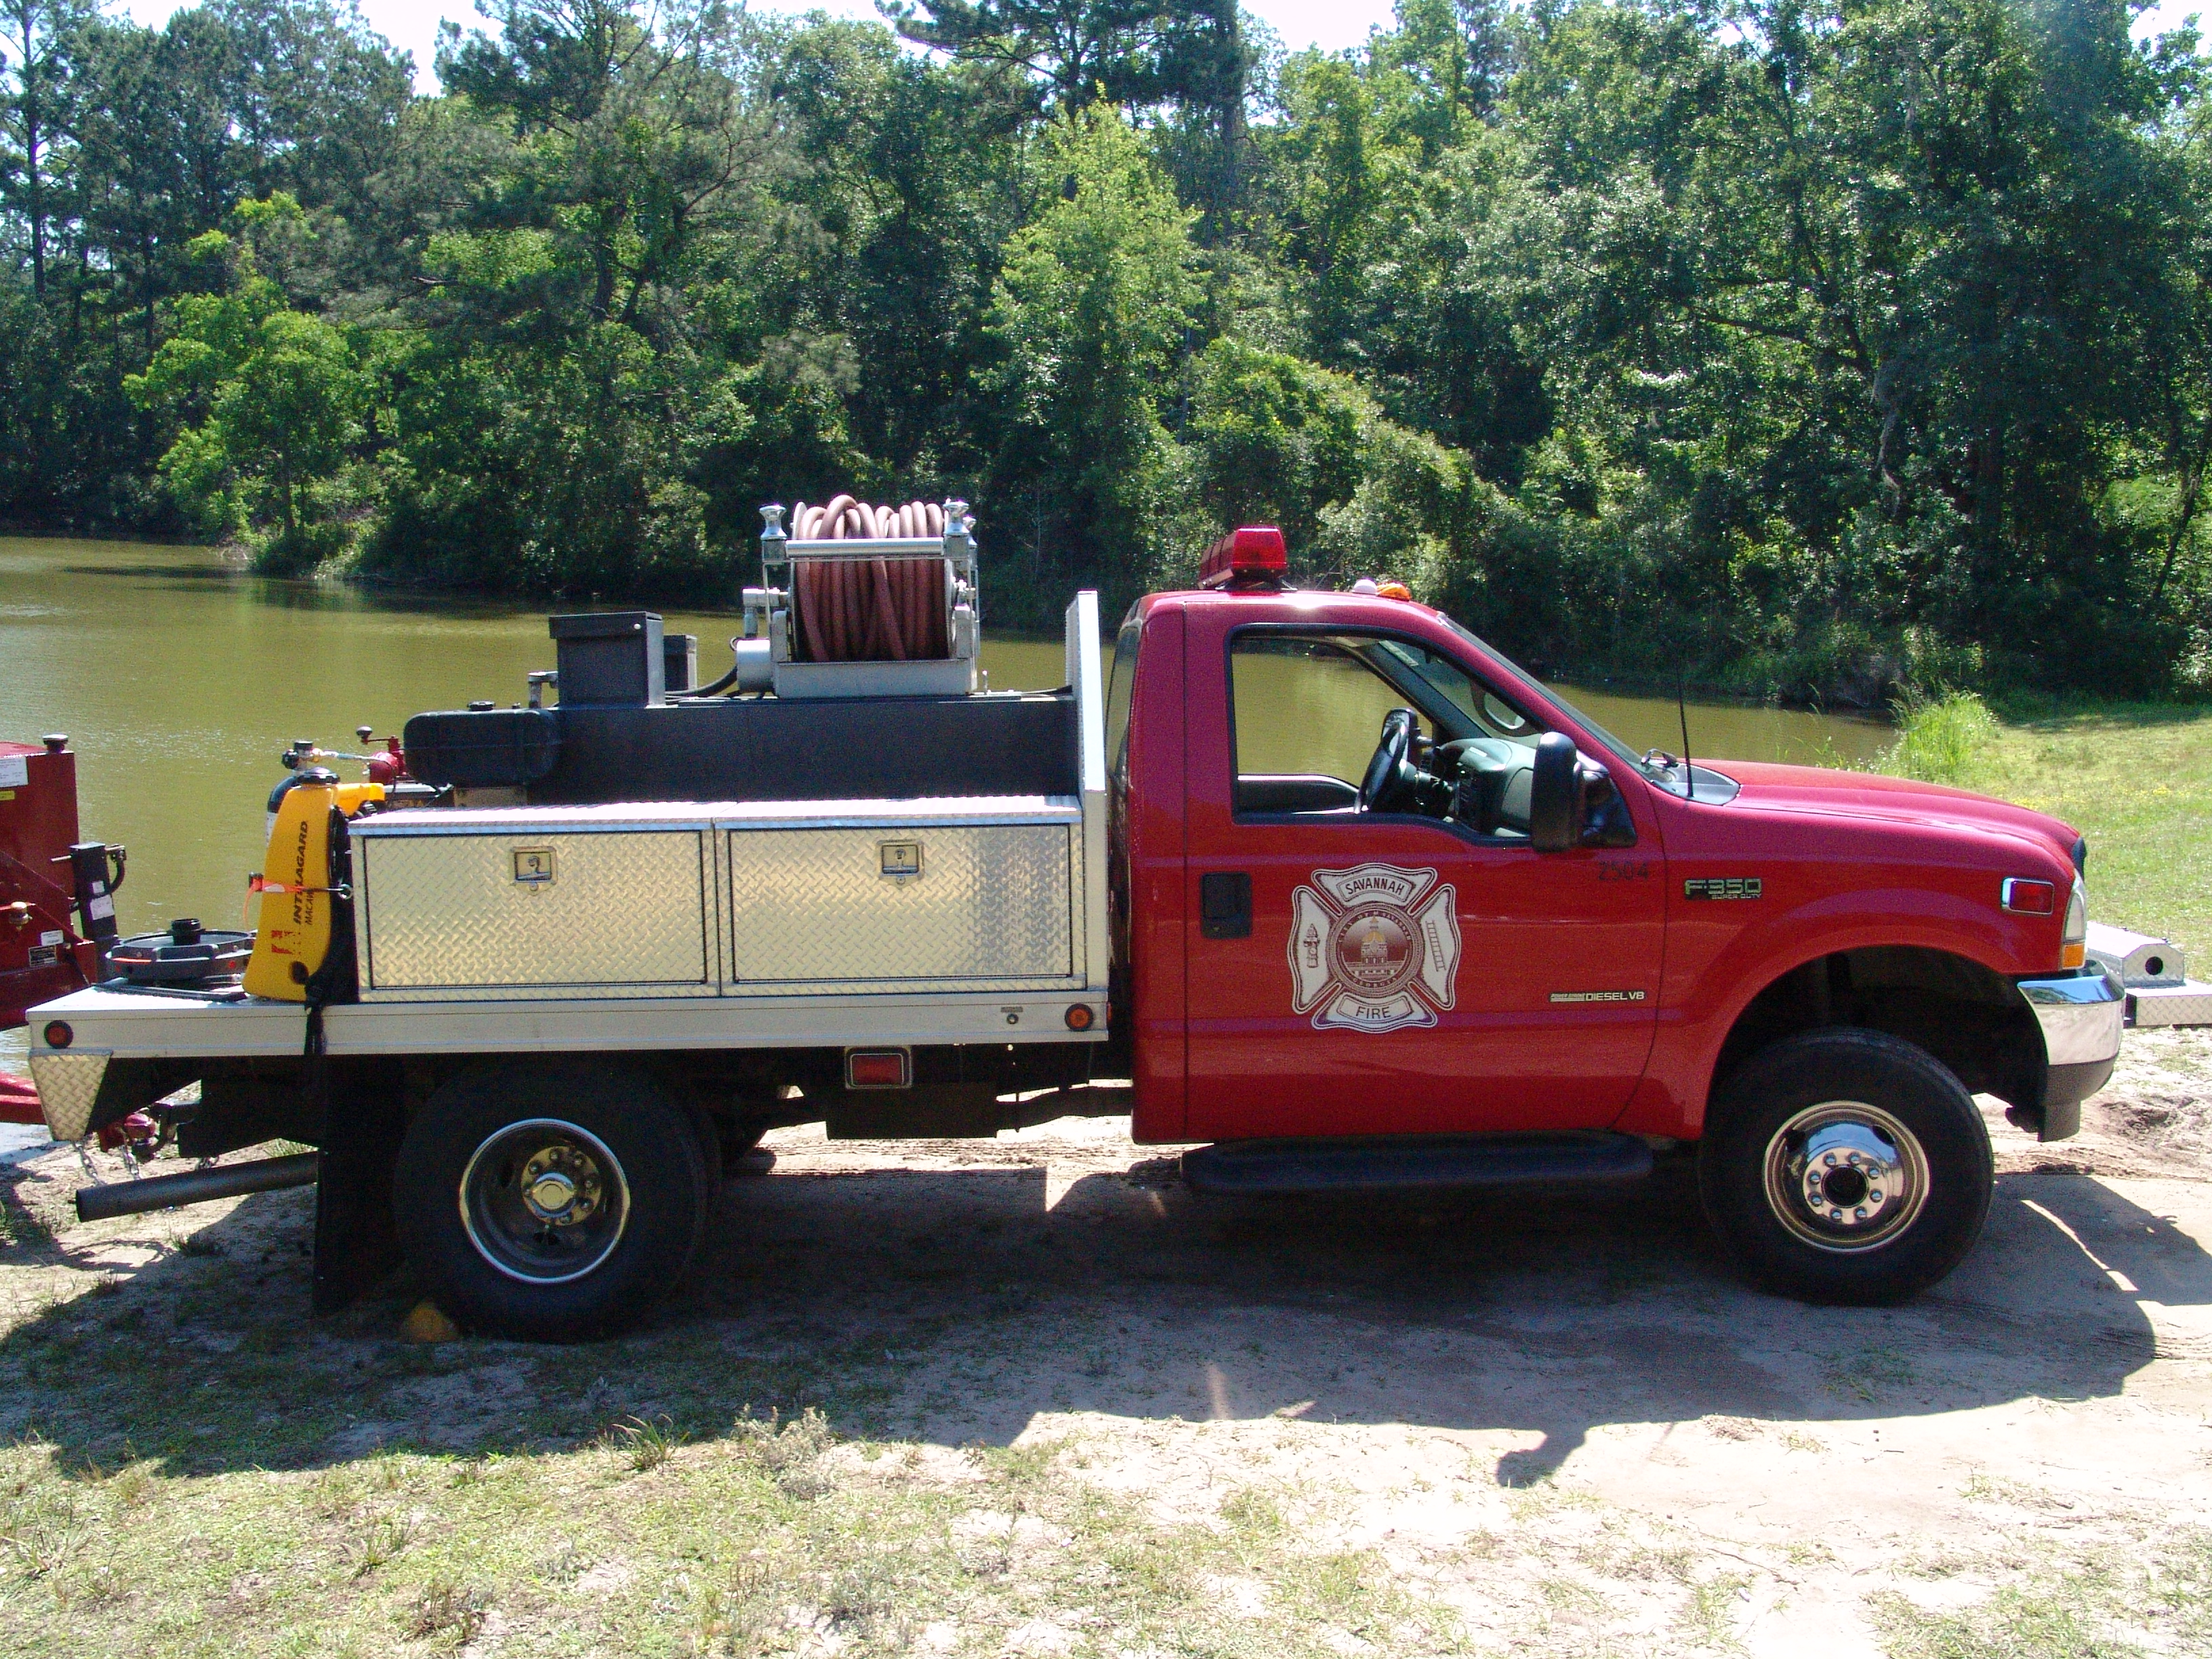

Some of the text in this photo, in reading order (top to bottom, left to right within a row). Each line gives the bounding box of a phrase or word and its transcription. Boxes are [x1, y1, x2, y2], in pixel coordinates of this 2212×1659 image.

[293, 821, 308, 925] INTLAGARD
[1345, 877, 1405, 896] SAVANNAH
[1586, 991, 1645, 1001] DIESEL V8
[1355, 1006, 1391, 1019] FIRE
